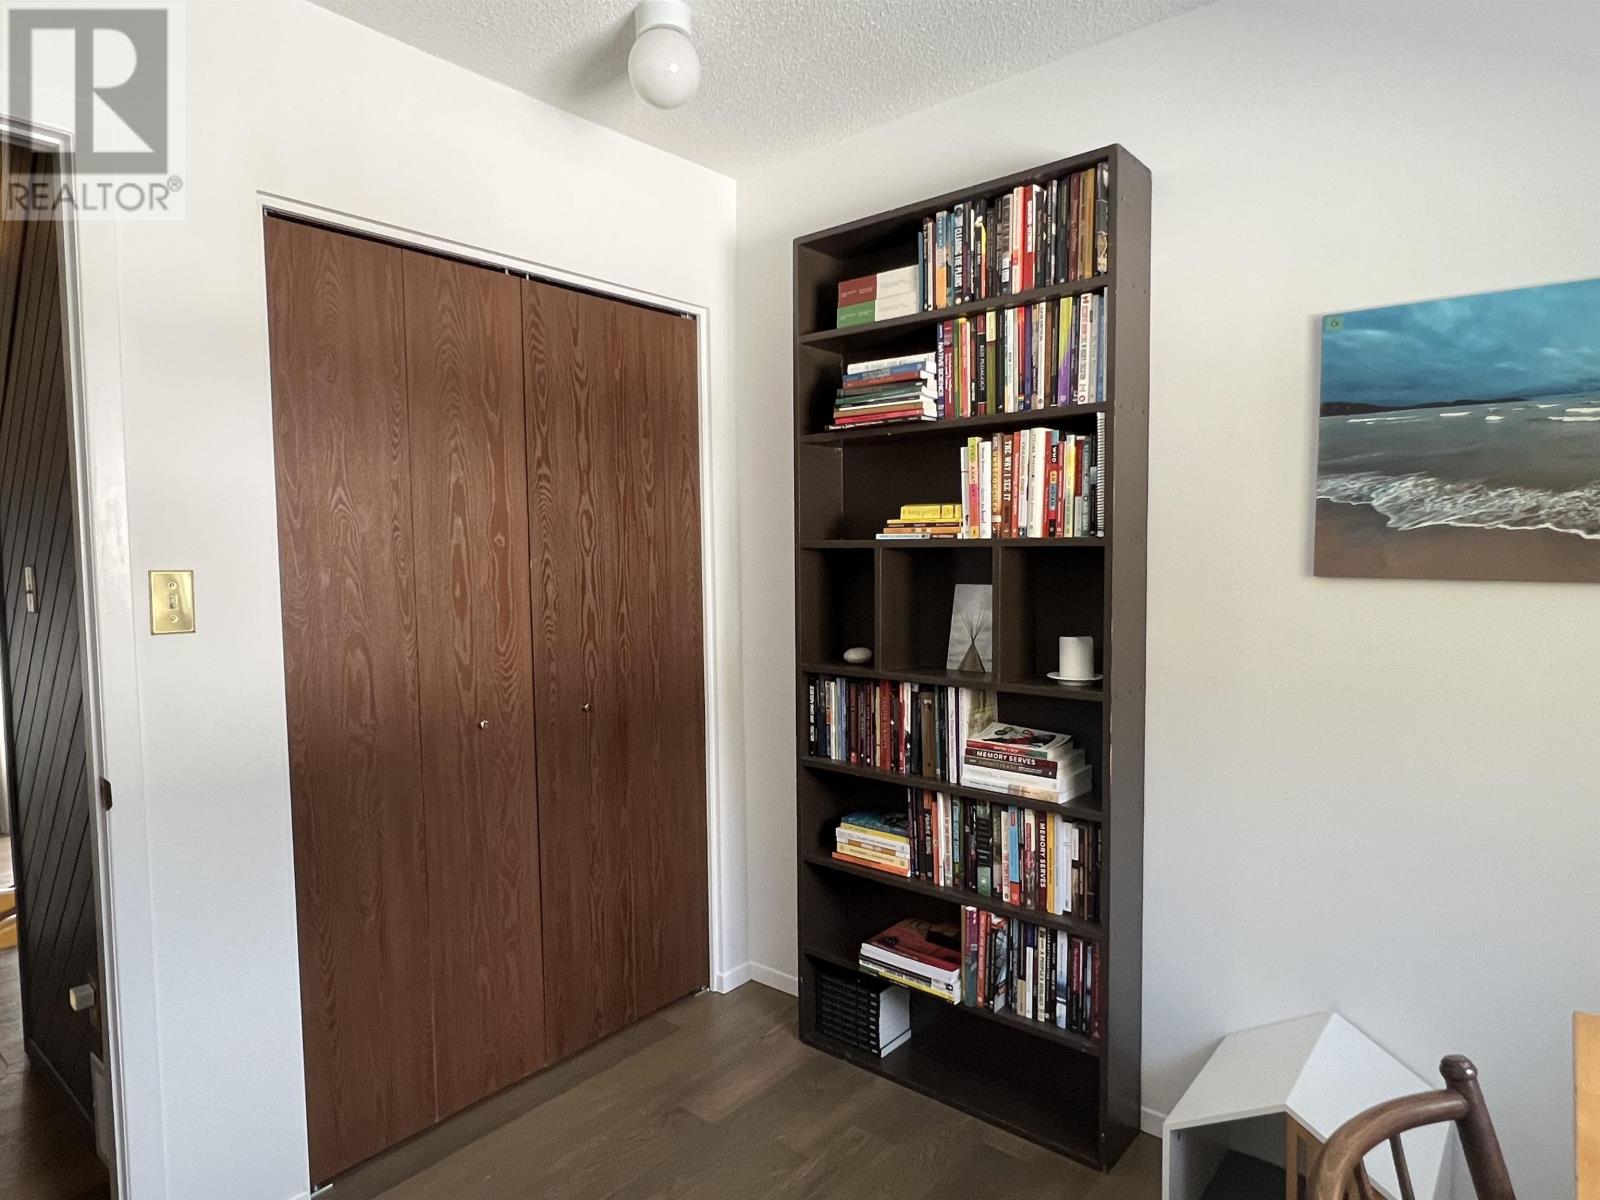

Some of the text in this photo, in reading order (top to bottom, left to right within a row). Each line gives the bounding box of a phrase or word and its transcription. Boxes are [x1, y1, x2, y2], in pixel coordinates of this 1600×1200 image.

[1004, 440, 1012, 455] THE
[1004, 456, 1012, 471] WAY
[1003, 478, 1011, 492] SEE
[1003, 493, 1011, 502] IT
[976, 750, 1008, 761] MEMORY
[1008, 755, 1036, 766] SERVES
